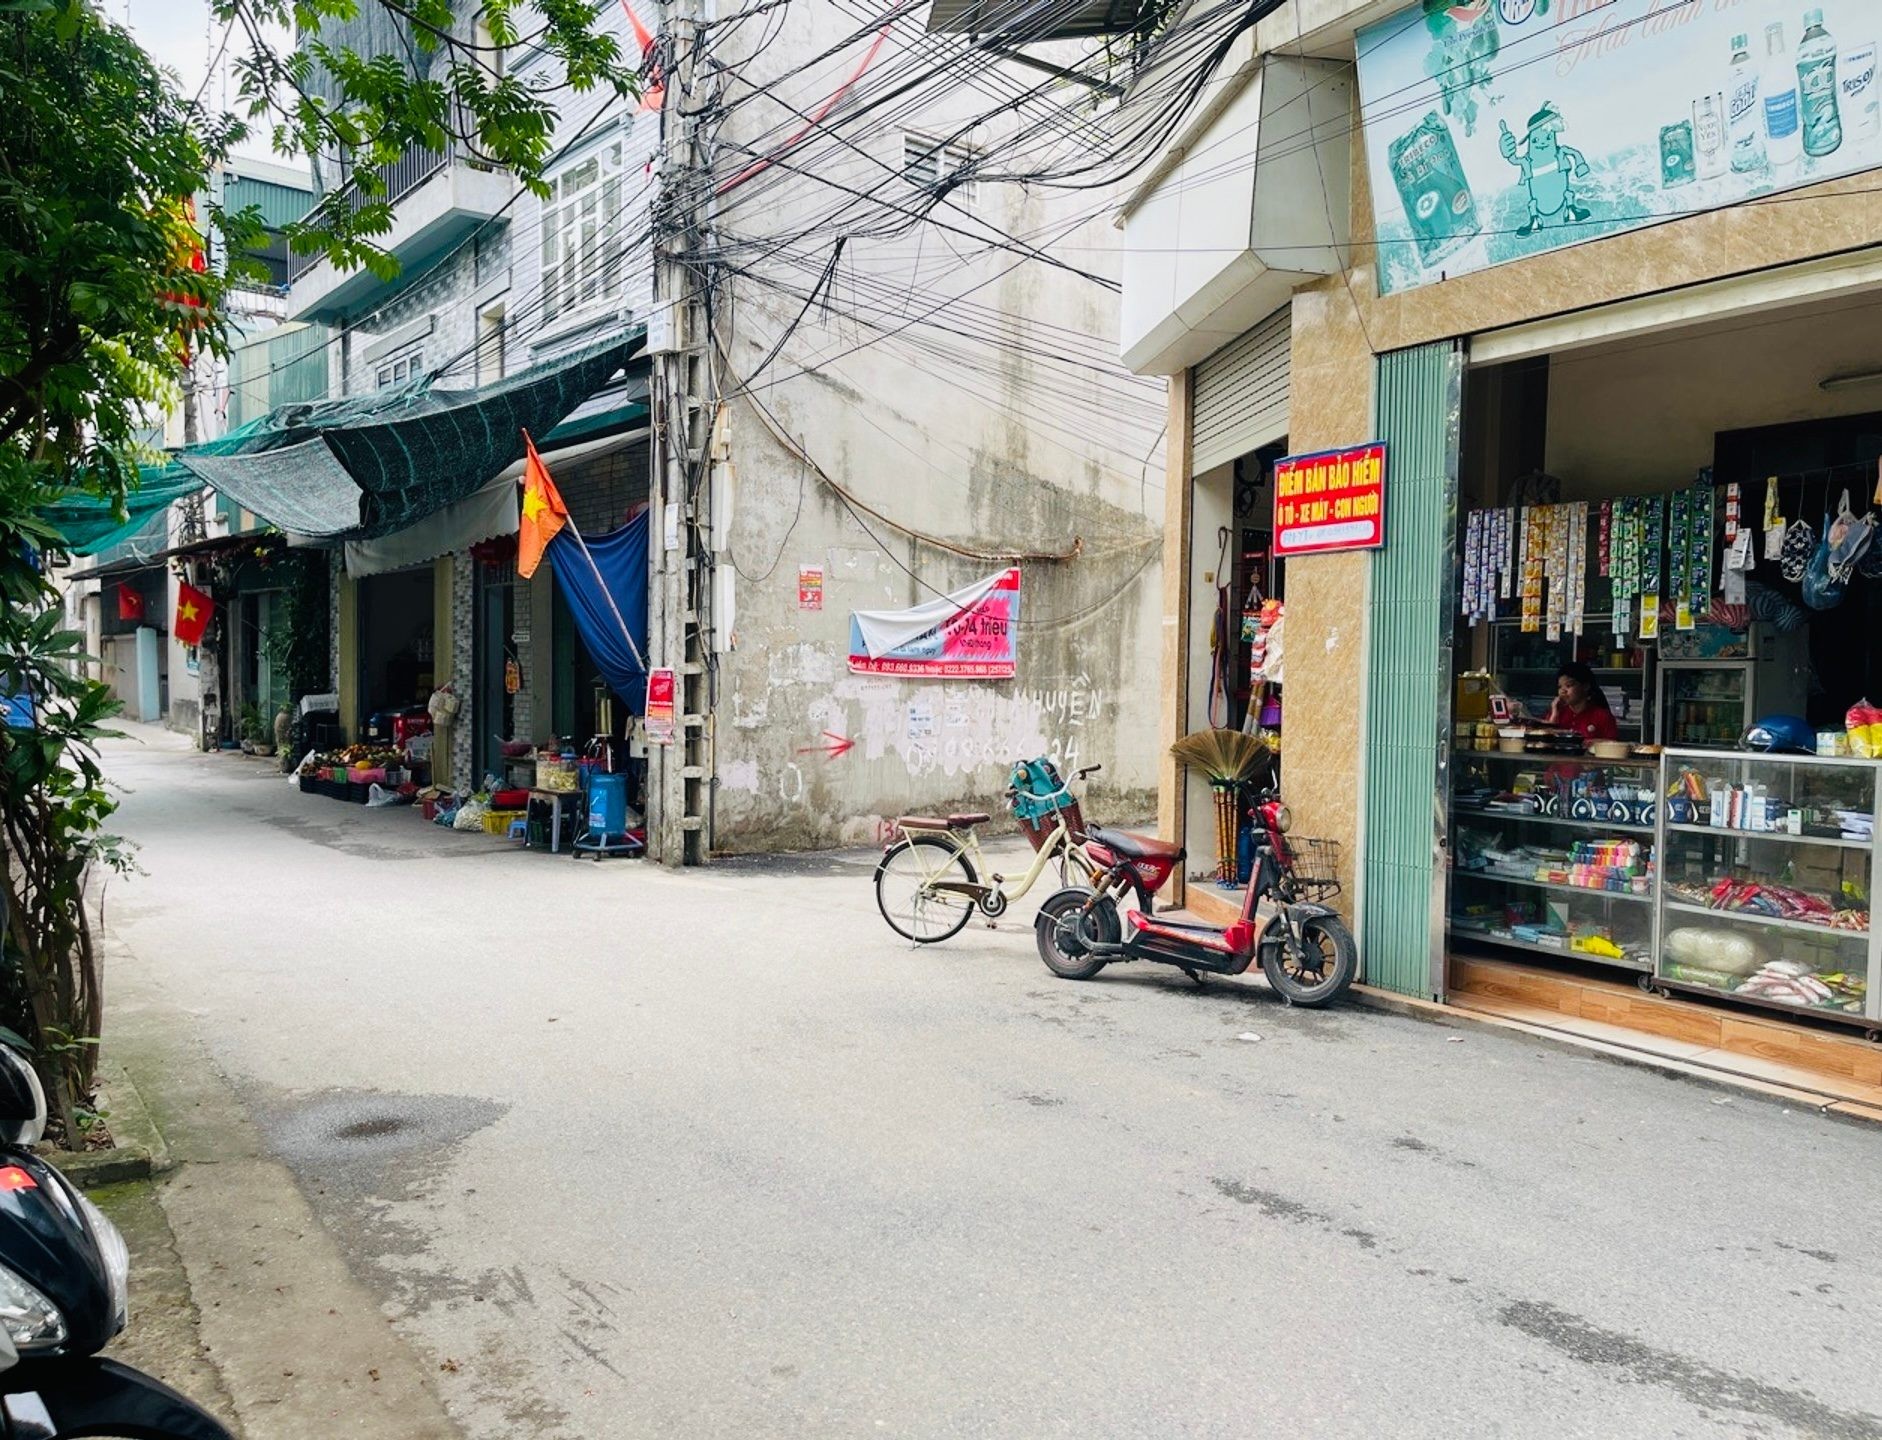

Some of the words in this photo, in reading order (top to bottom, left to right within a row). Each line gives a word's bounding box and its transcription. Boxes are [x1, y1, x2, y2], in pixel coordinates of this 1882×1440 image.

[1305, 461, 1326, 494] BÁN
[1328, 455, 1350, 491] BẢO
[1352, 448, 1381, 487] HIỂM
